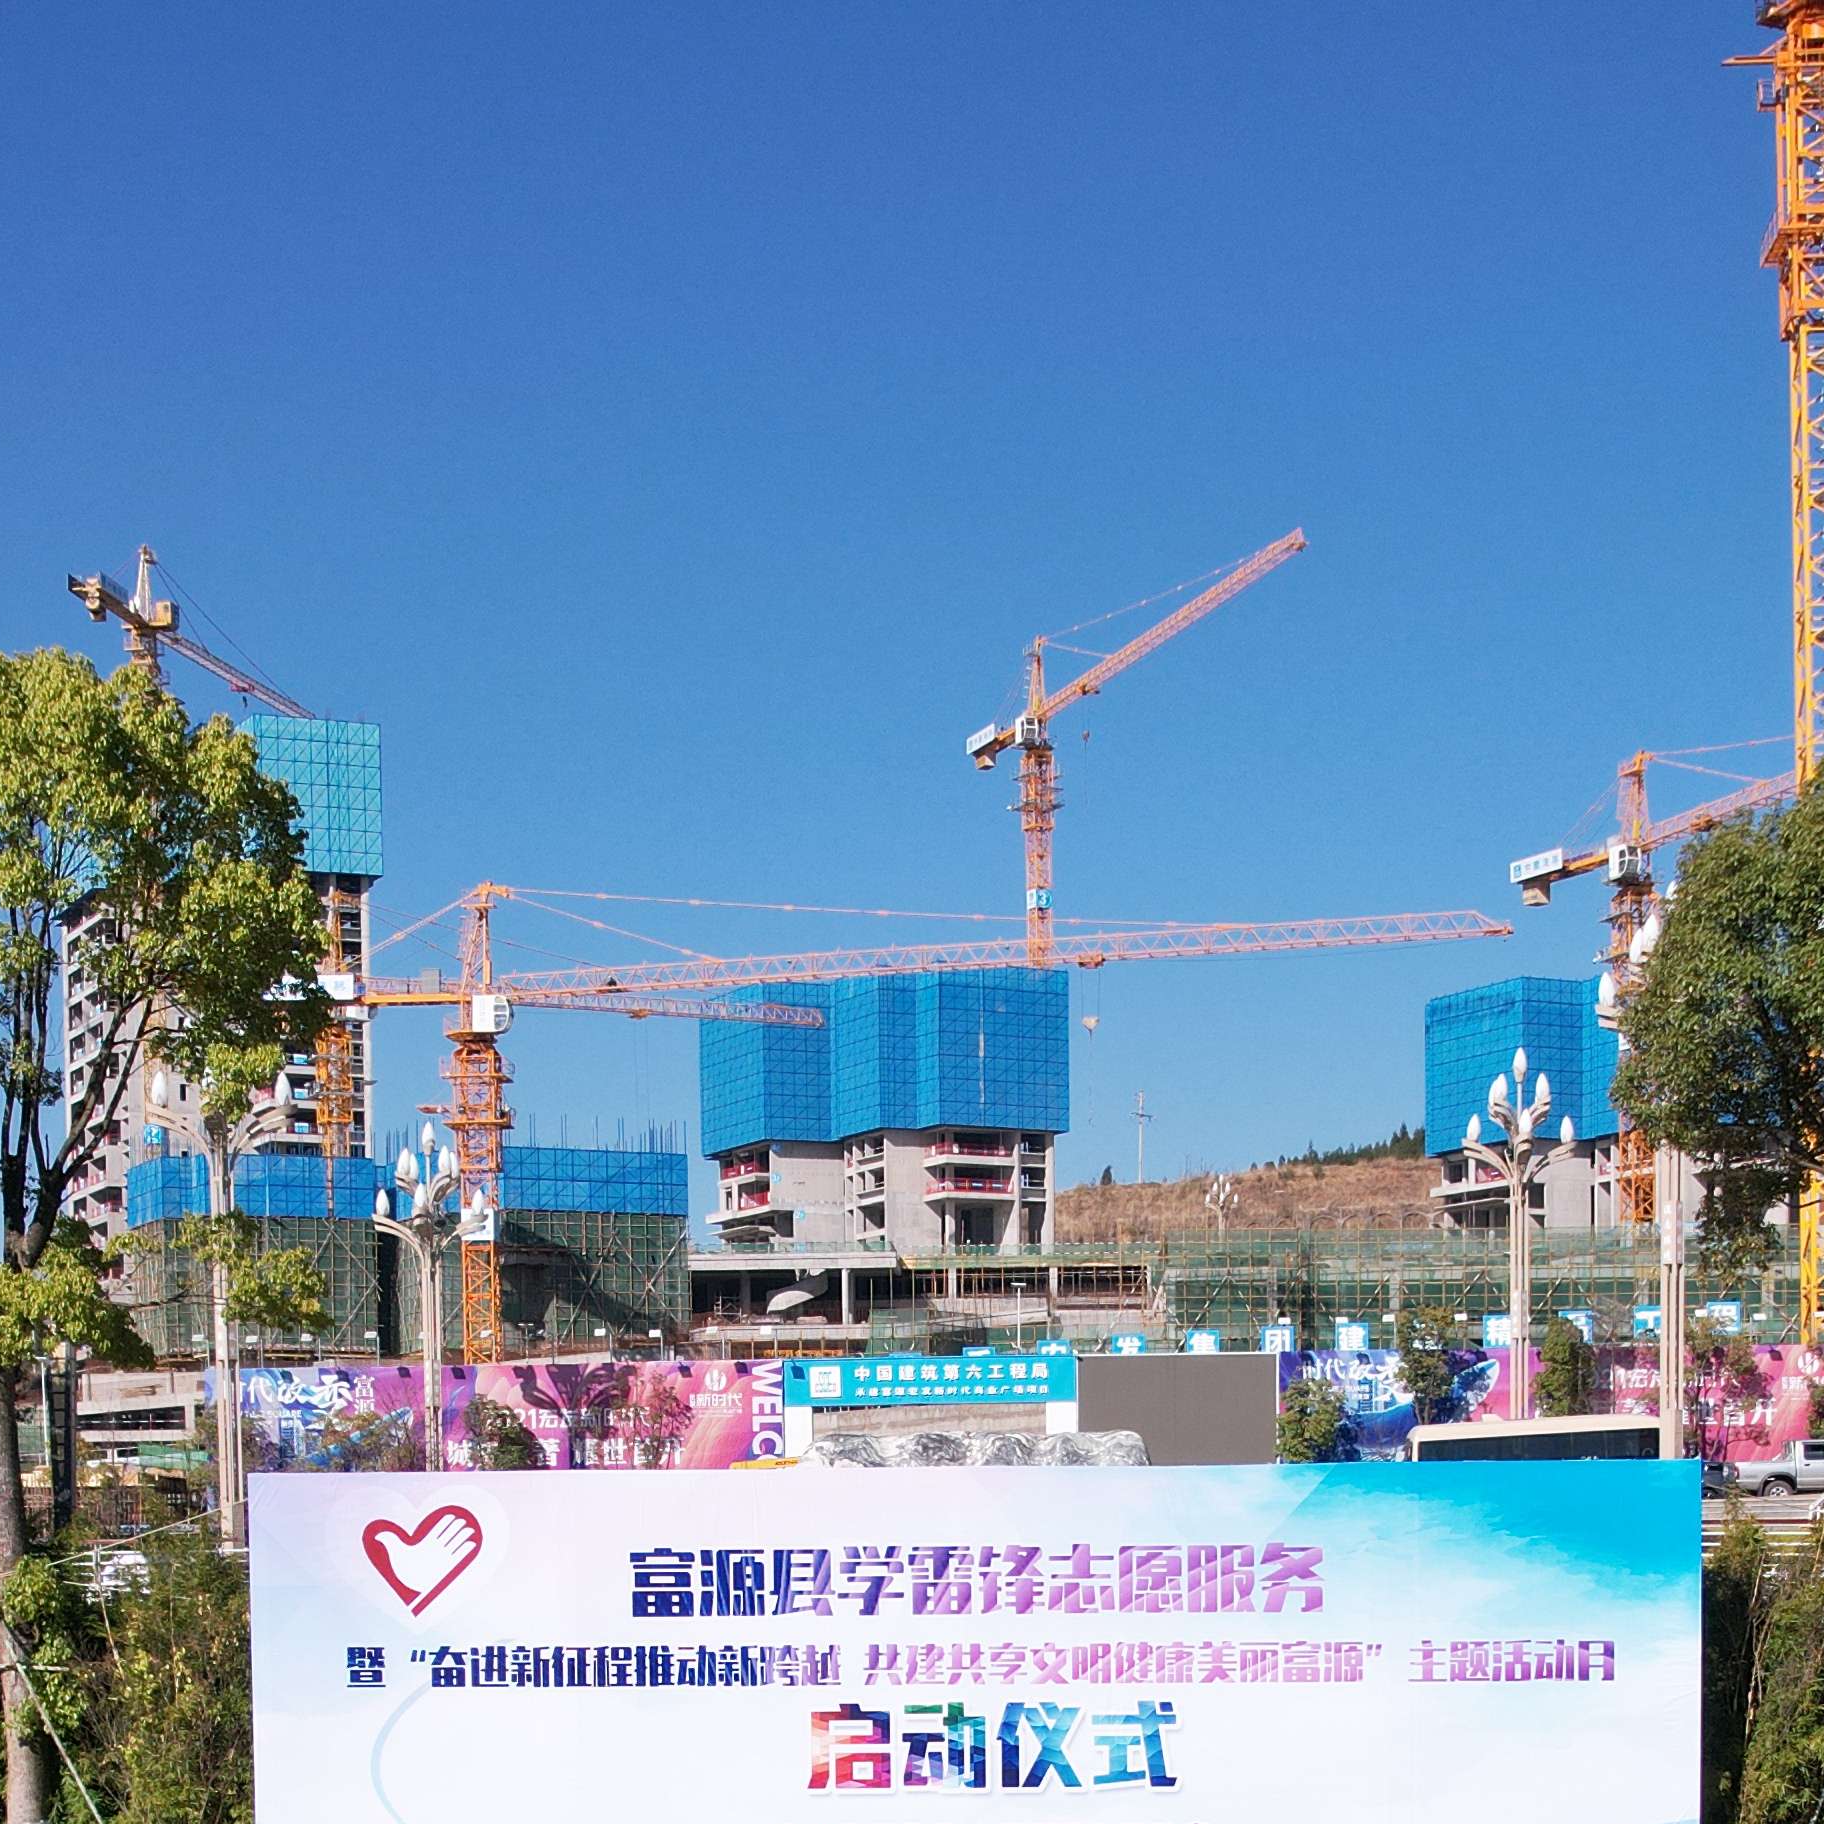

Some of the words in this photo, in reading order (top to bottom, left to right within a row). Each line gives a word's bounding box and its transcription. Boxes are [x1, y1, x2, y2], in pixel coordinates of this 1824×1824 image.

[854, 1363, 1050, 1382] 中国建筑第六工程局
[751, 1362, 784, 1462] WELC
[629, 1543, 1325, 1618] 富源县学雷锋志愿服务
[346, 1646, 387, 1688] 暨
[1407, 1639, 1617, 1684] 主题活动月
[807, 1699, 1181, 1791] 启动仪式
